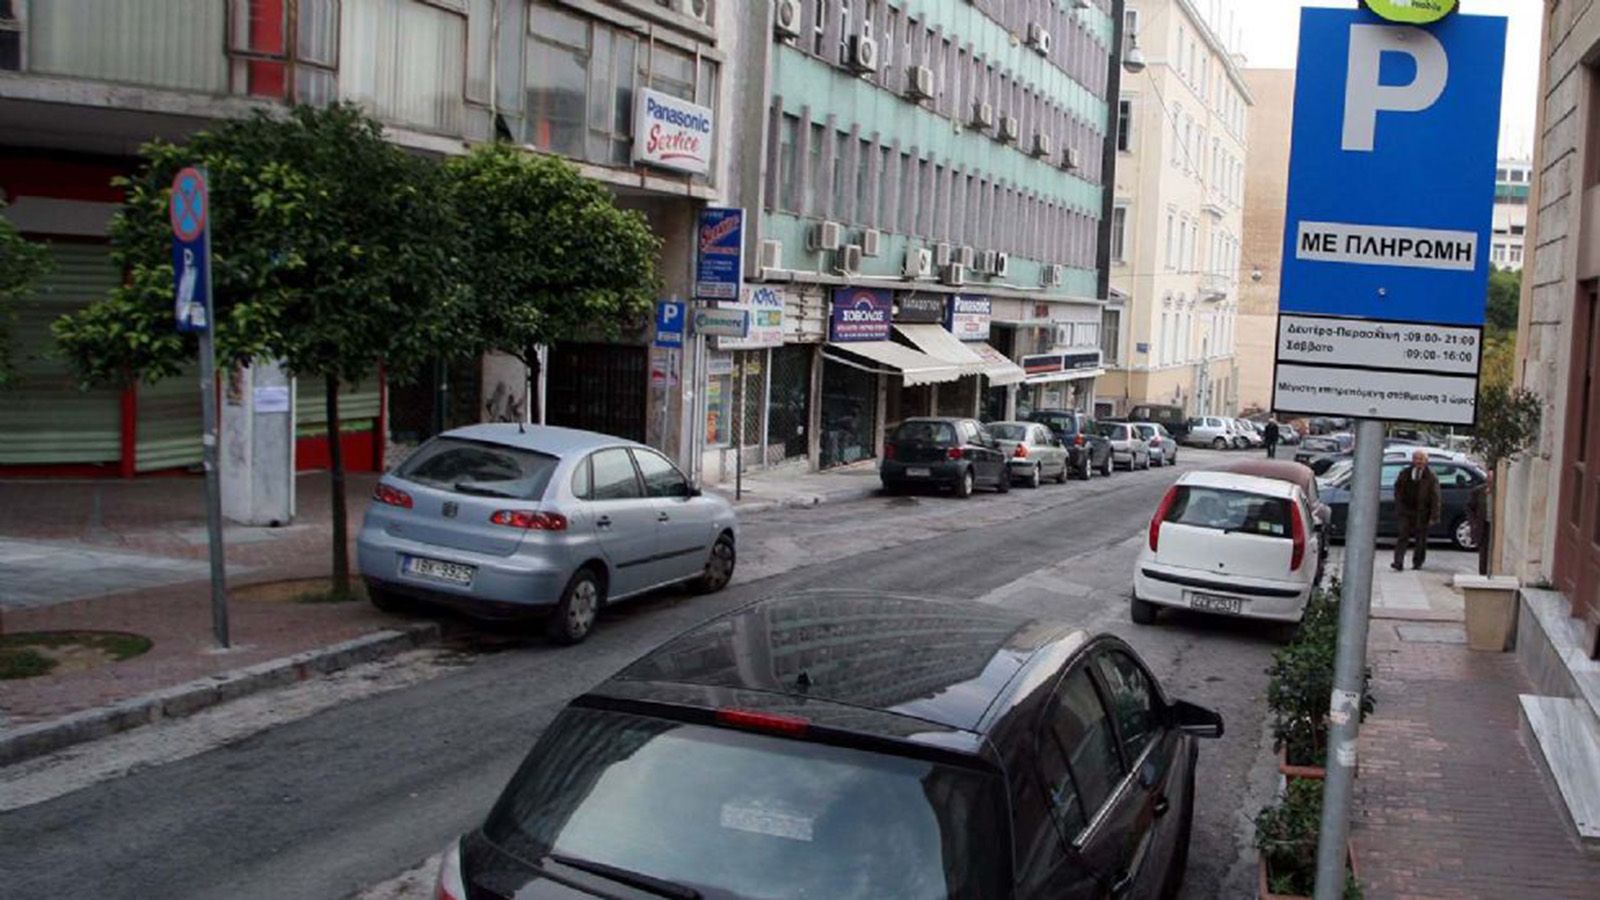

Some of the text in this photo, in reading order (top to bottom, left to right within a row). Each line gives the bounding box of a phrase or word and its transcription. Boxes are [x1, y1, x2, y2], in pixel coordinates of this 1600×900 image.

[1341, 24, 1449, 152] P
[647, 97, 710, 134] Panasonic
[647, 123, 700, 154] Service
[1301, 233, 1473, 262] ΜΕ ΠΛΗΡΩΜΗ
[663, 304, 678, 324] P
[954, 297, 991, 313] Panasonic
